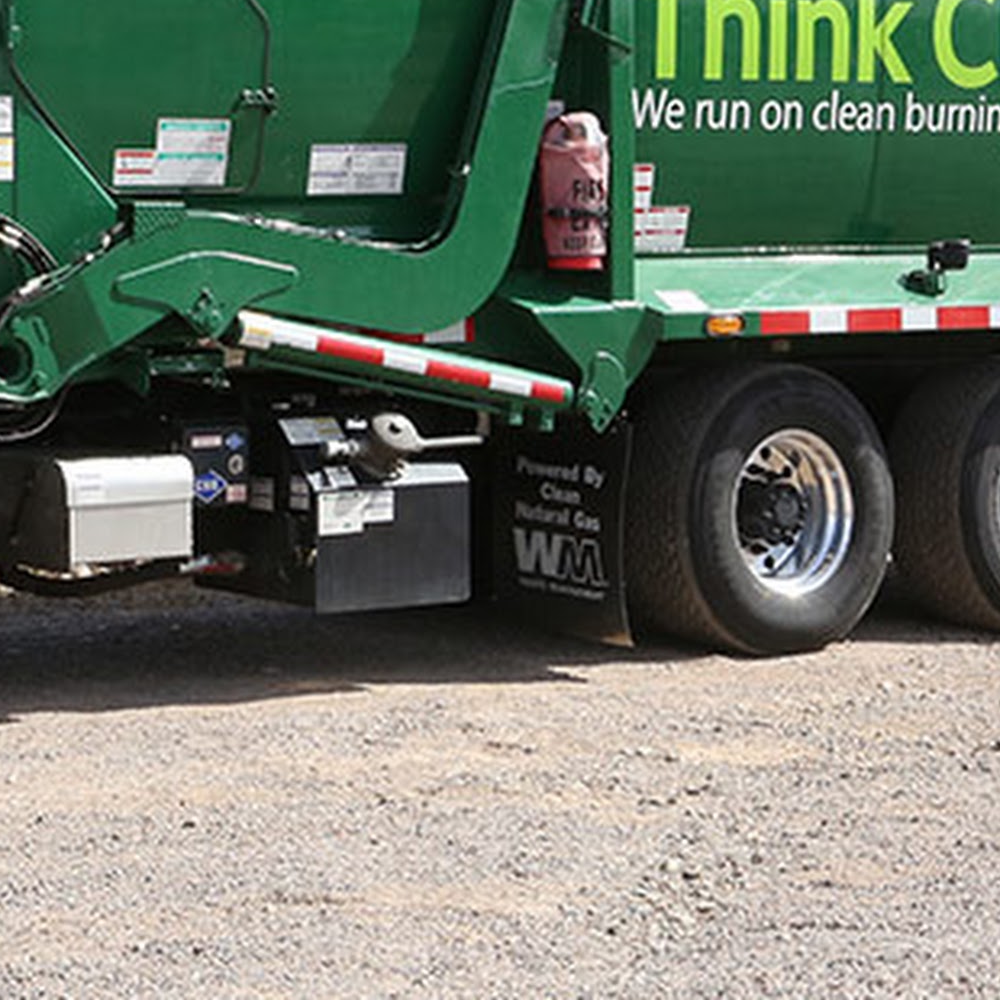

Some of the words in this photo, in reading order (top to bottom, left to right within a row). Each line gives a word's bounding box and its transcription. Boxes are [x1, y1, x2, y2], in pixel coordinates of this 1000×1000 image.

[631, 88, 686, 131] We
[695, 97, 751, 131] run
[760, 98, 801, 131] on
[812, 89, 895, 132] clean
